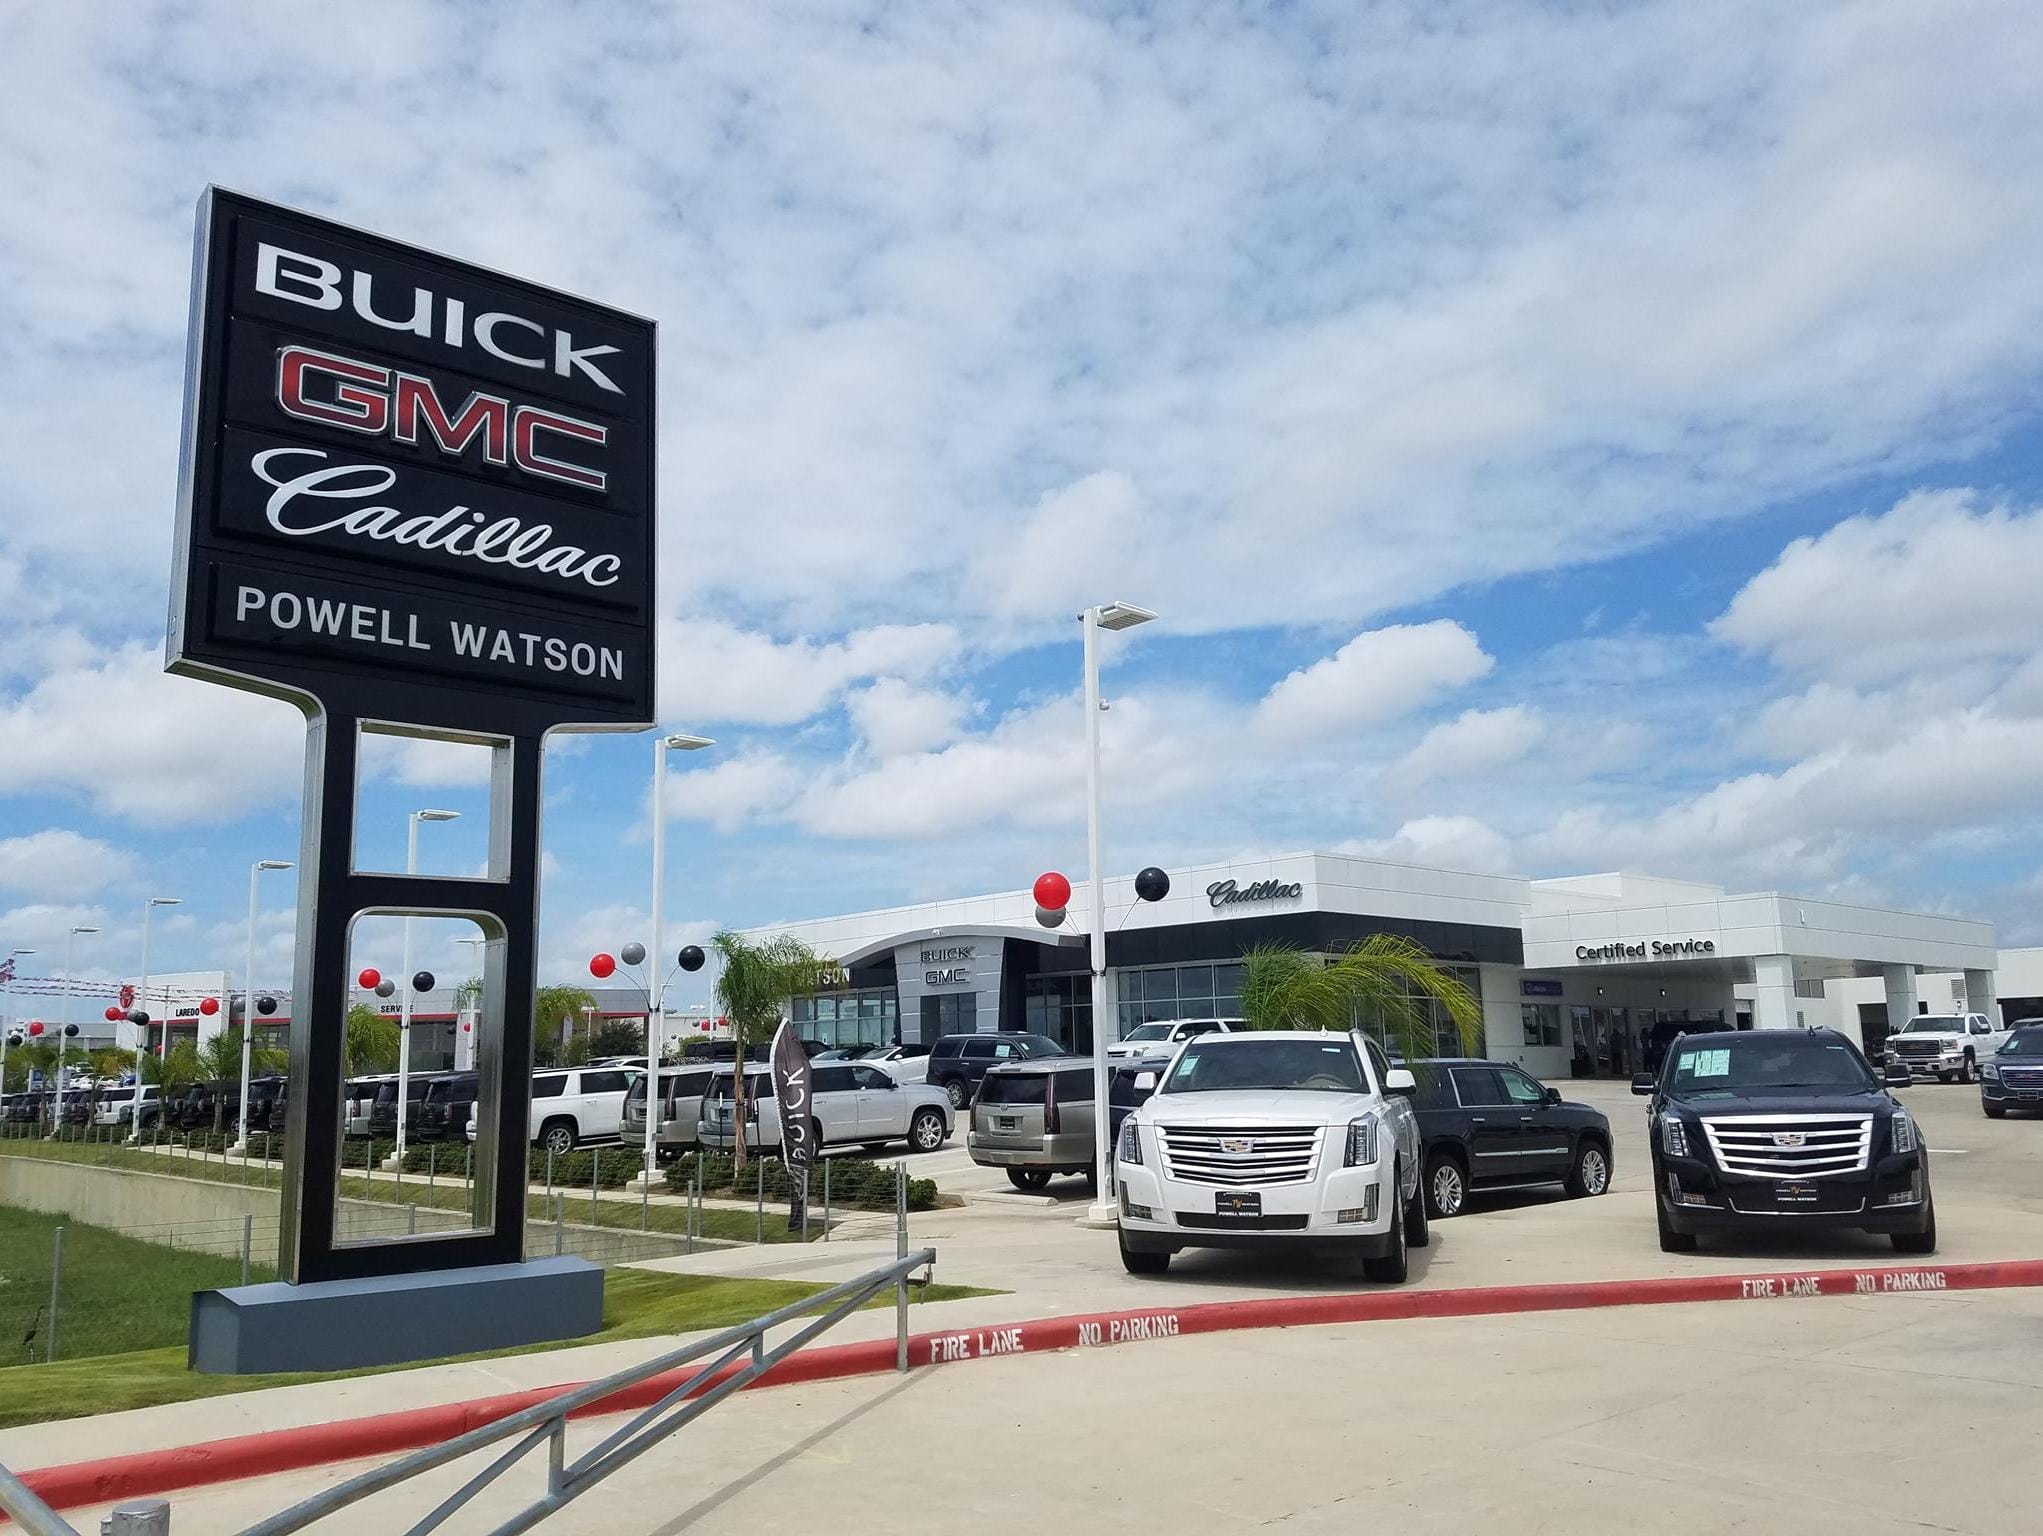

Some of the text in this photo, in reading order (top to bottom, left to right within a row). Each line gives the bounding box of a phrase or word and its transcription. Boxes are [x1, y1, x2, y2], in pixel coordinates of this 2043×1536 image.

[254, 242, 627, 397] BUICK
[275, 344, 609, 493] GMC
[250, 447, 622, 587] Cadillac
[236, 585, 624, 681] POWELL WATSON
[1206, 878, 1302, 908] Cadillac
[920, 946, 976, 963] BUICK
[1575, 938, 1714, 960] Certified Service
[924, 968, 968, 986] GMC
[175, 1007, 200, 1017] LAREDO
[1741, 1271, 1947, 1299] FIRE LANE NO PARKING
[929, 1314, 1179, 1363] FIRE LANE NO PARKING
